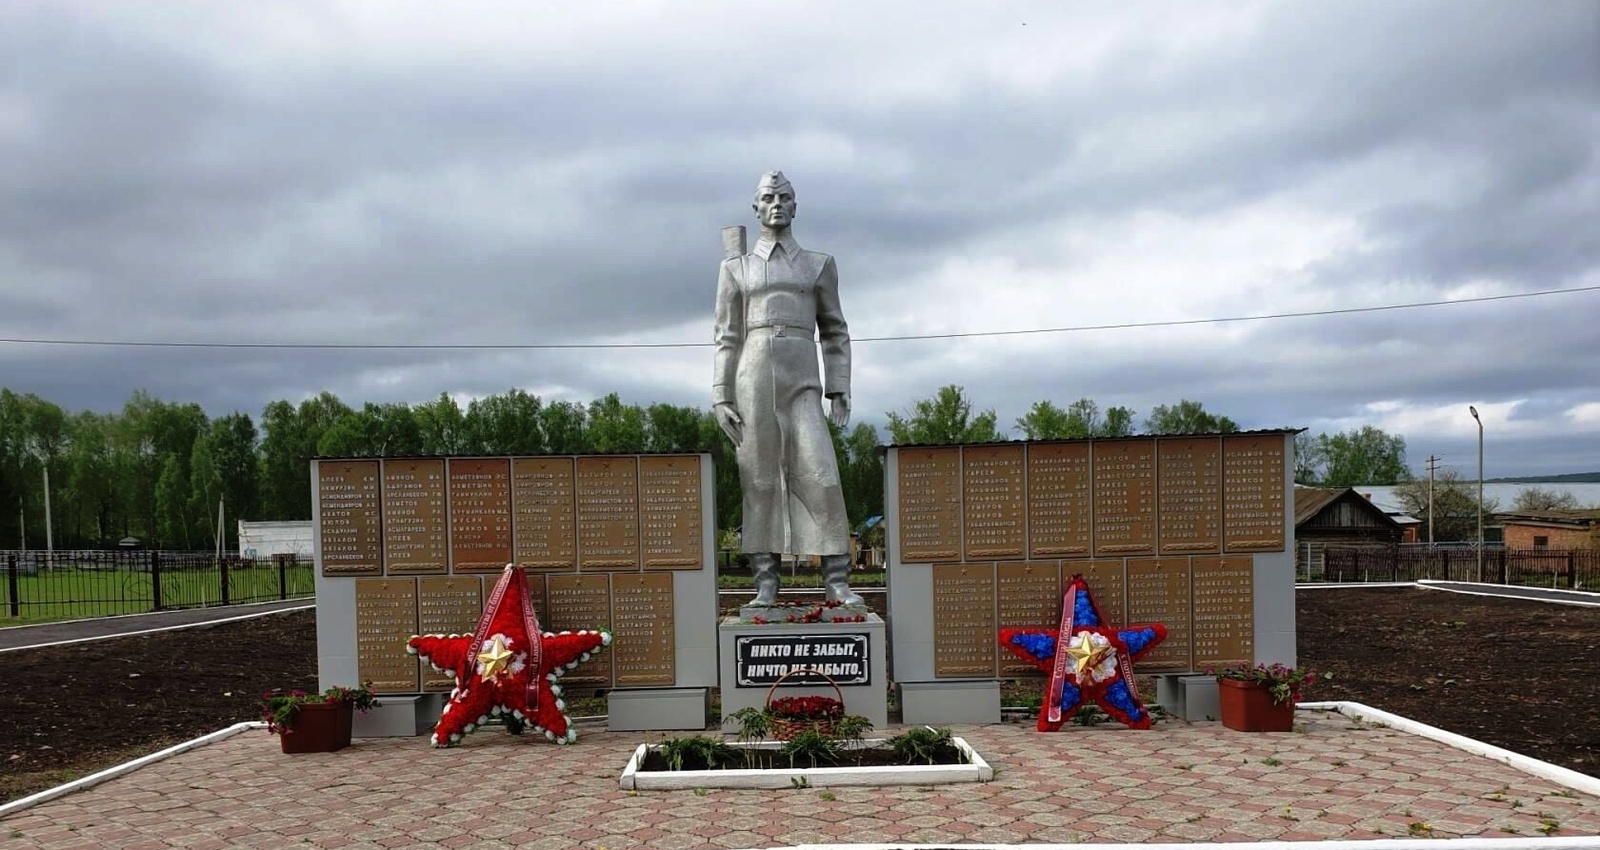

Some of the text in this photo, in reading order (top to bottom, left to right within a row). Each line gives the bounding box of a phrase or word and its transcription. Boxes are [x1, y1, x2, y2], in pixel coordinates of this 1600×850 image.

[470, 612, 490, 650] Отечества
[751, 643, 858, 657] НИКТО НЕ ЗАБЫТ,
[1056, 644, 1066, 678] Солдату
[748, 663, 861, 677] НИЧТО НЕ ЗАБЫТО.
